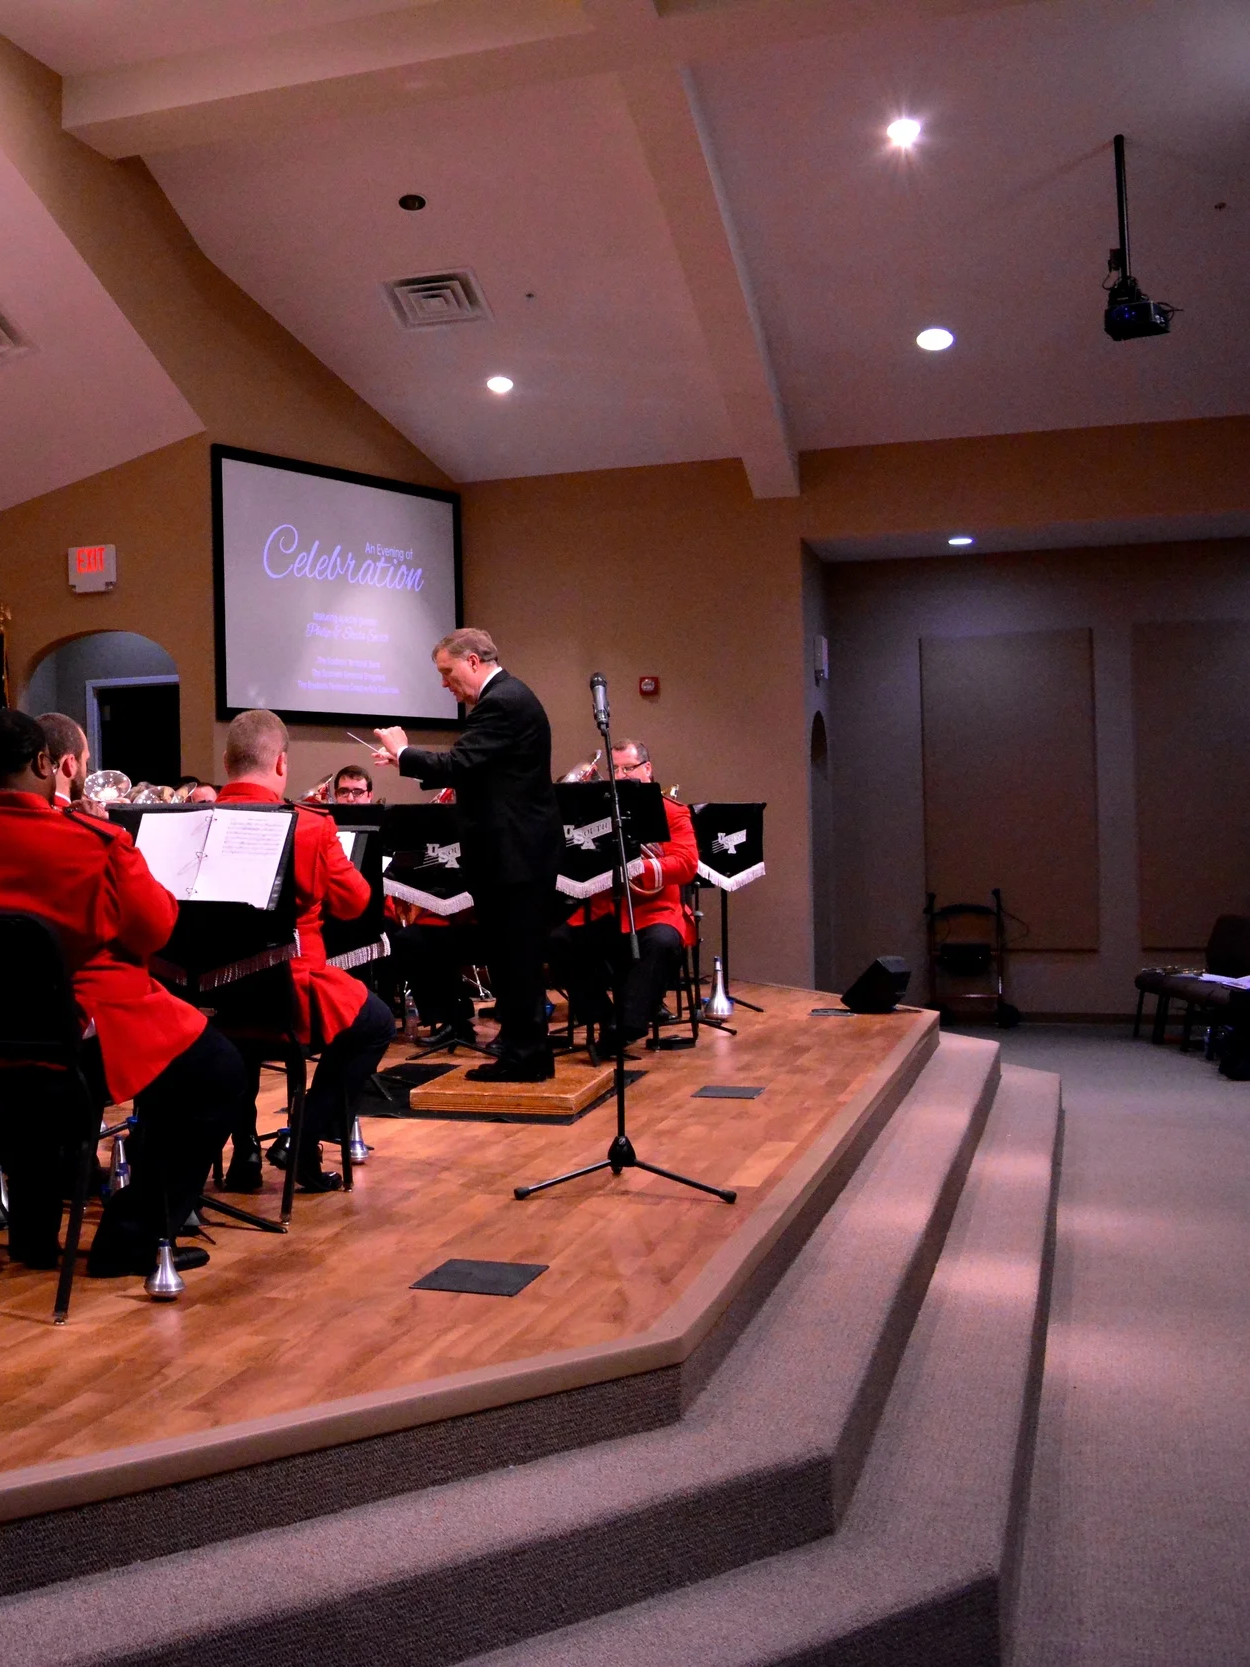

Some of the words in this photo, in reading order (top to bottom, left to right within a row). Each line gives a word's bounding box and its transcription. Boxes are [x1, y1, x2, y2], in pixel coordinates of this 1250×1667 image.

[76, 547, 106, 573] EXIT
[263, 523, 425, 592] Celebration
[364, 541, 375, 556] An
[376, 543, 405, 562] Evening
[405, 547, 414, 560] of
